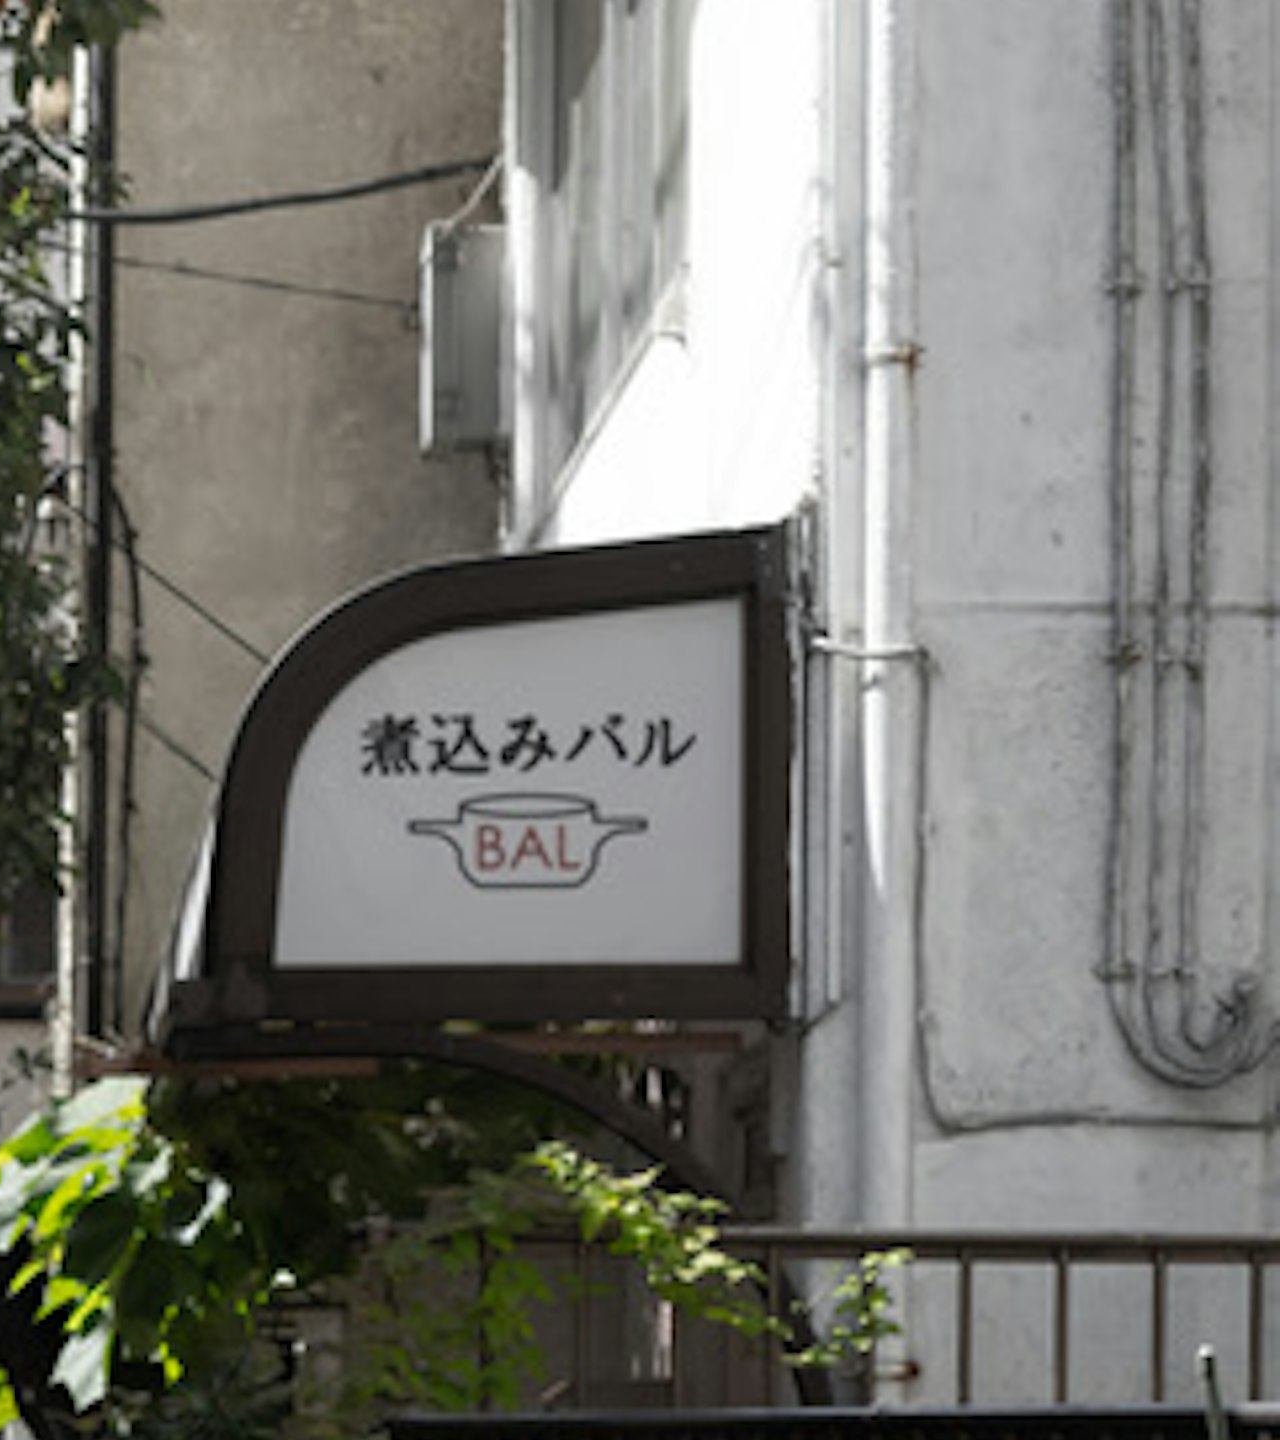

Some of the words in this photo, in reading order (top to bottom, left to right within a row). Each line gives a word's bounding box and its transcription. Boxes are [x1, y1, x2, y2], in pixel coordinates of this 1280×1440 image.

[359, 712, 698, 777] 煮込みバル
[473, 824, 581, 873] BAL
